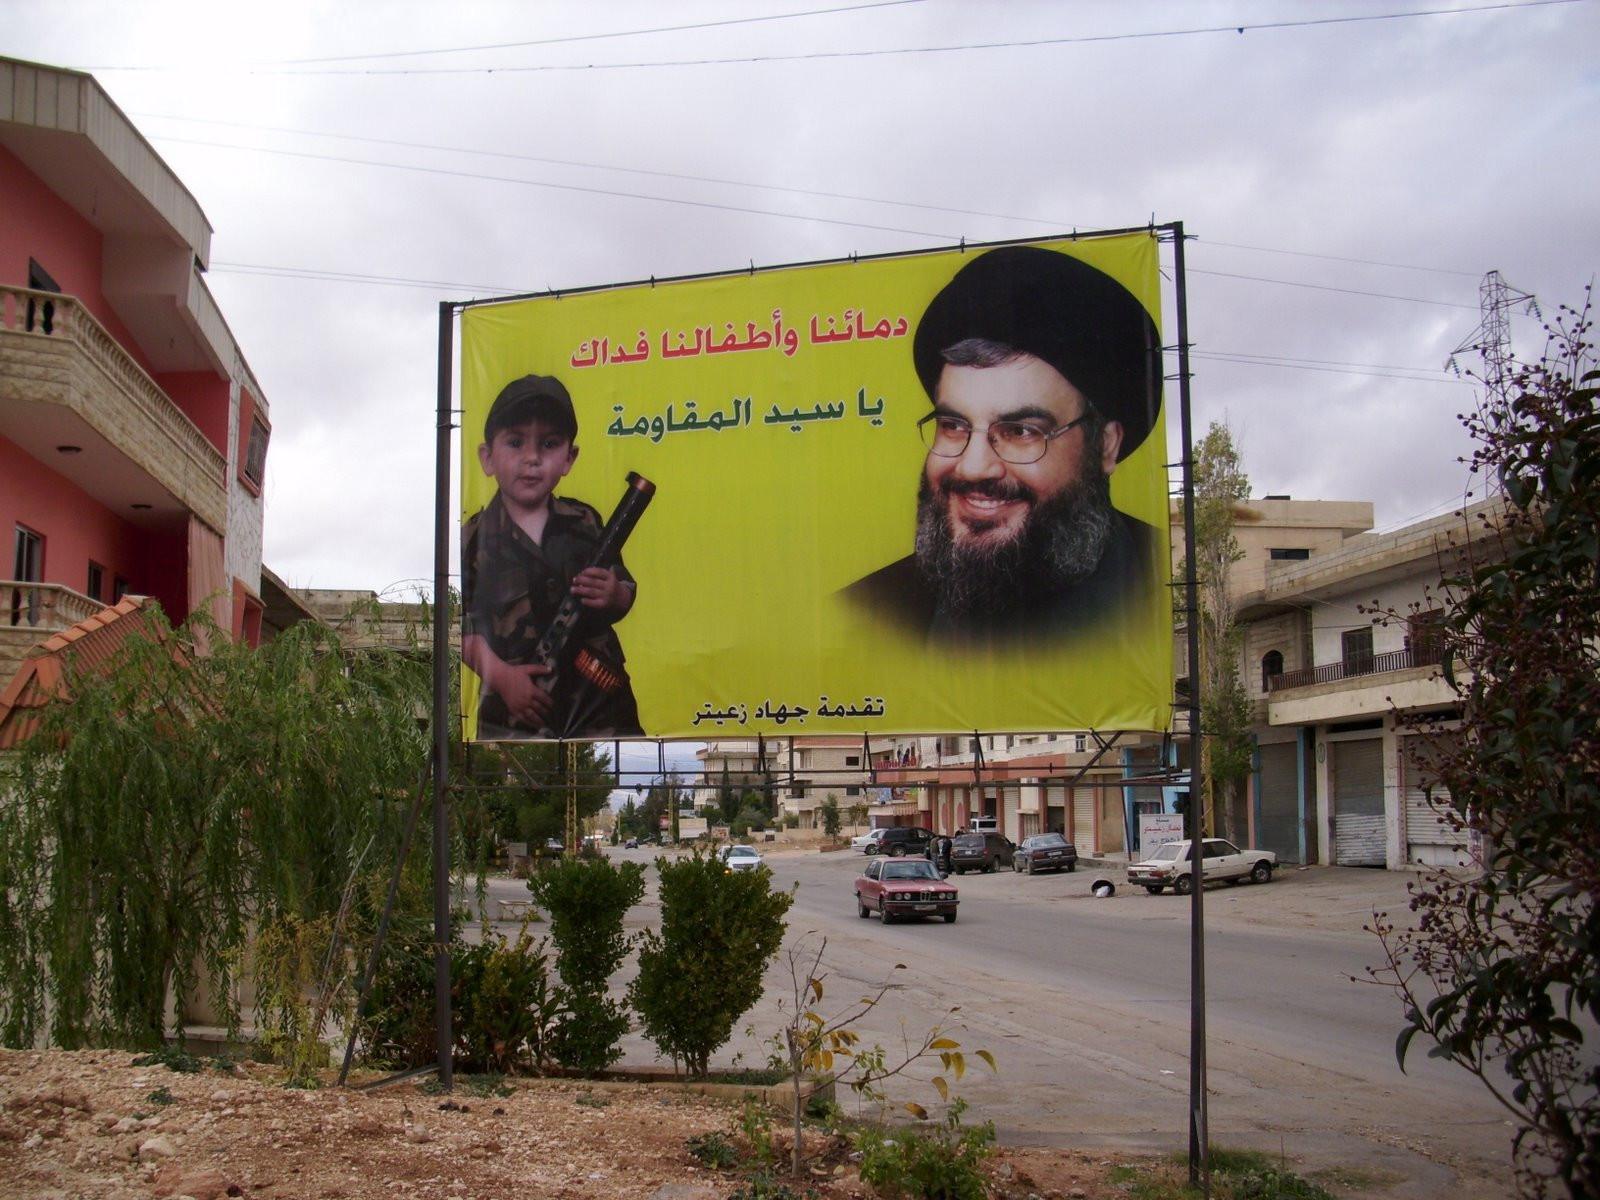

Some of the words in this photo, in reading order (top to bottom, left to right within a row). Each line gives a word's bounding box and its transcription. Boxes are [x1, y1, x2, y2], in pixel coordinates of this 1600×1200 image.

[660, 308, 801, 360] وأطفالنا
[809, 308, 910, 346] دمائنا
[570, 330, 651, 369] فداك
[606, 396, 751, 443] المقاومة
[763, 400, 845, 432] سيد
[857, 387, 884, 426] يا
[691, 703, 748, 726] زعيتر
[754, 700, 810, 725] جهاد
[816, 696, 885, 718] تقدمة
